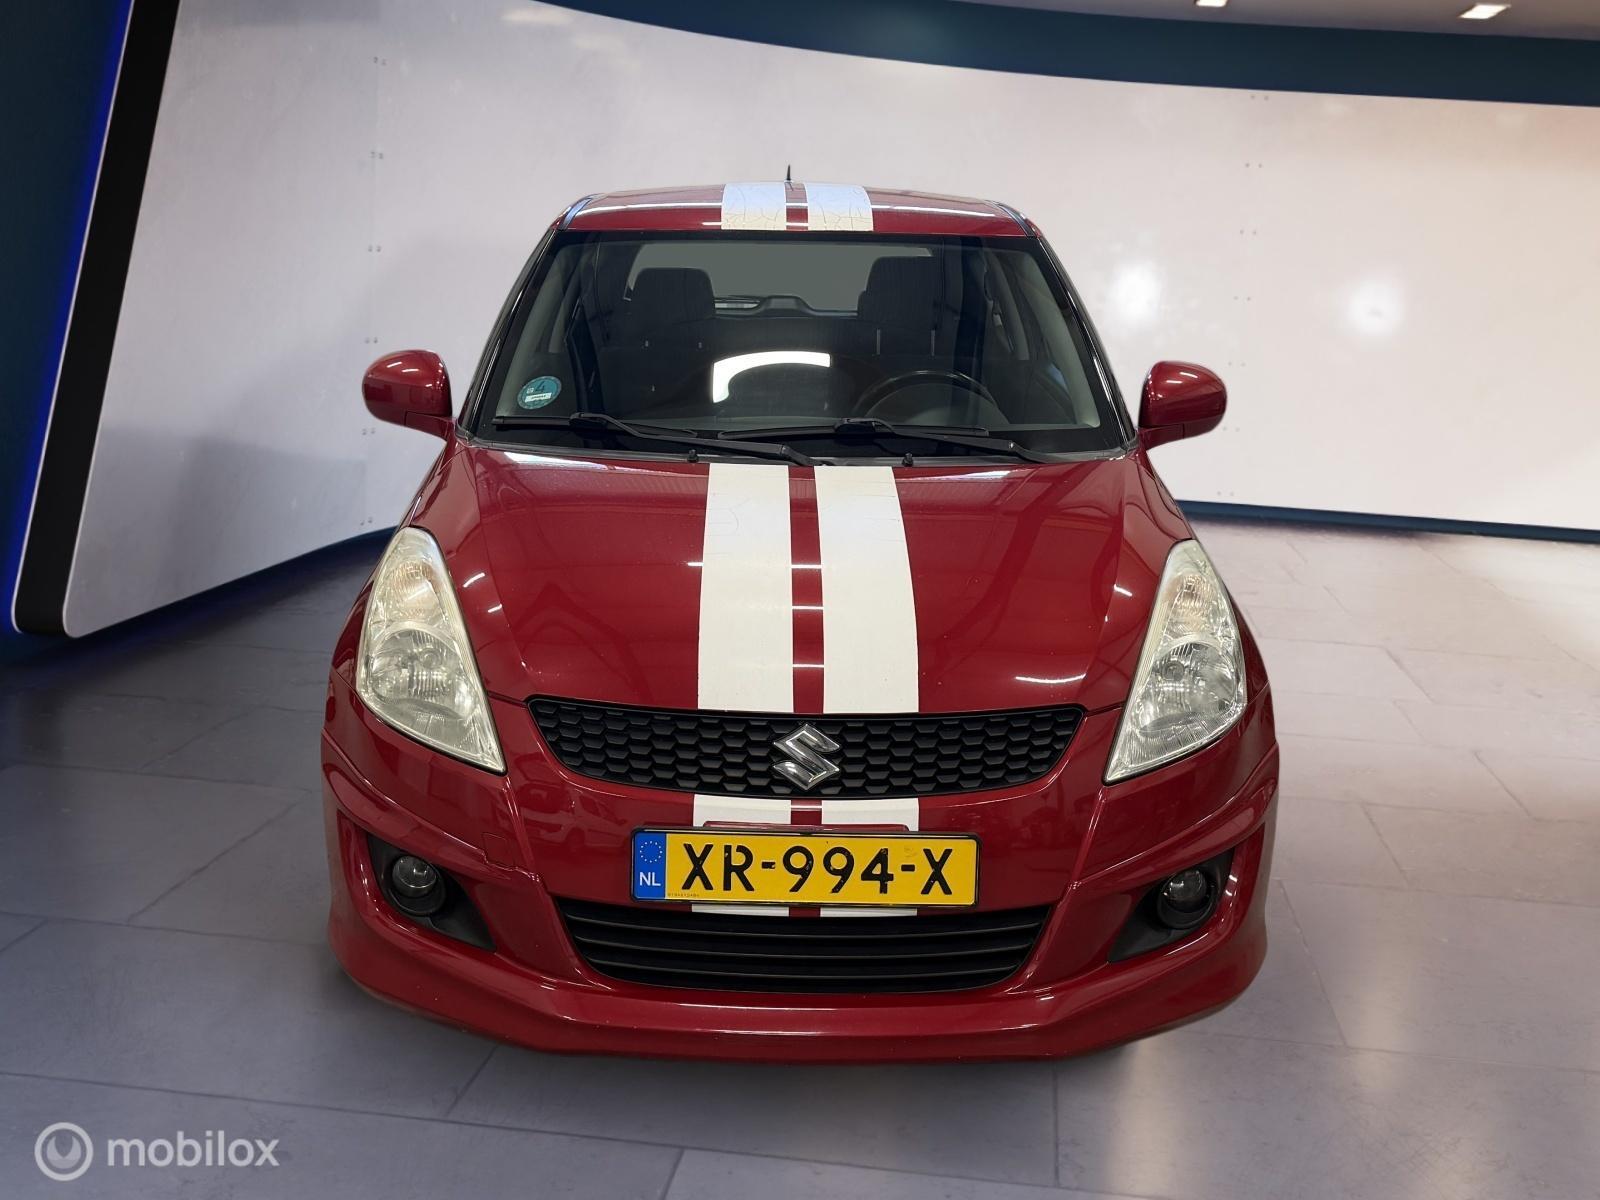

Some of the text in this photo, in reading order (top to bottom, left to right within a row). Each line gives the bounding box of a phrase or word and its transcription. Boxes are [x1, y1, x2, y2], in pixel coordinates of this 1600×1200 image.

[535, 380, 545, 392] 4
[681, 843, 953, 895] XR-994-X
[639, 871, 661, 887] NL
